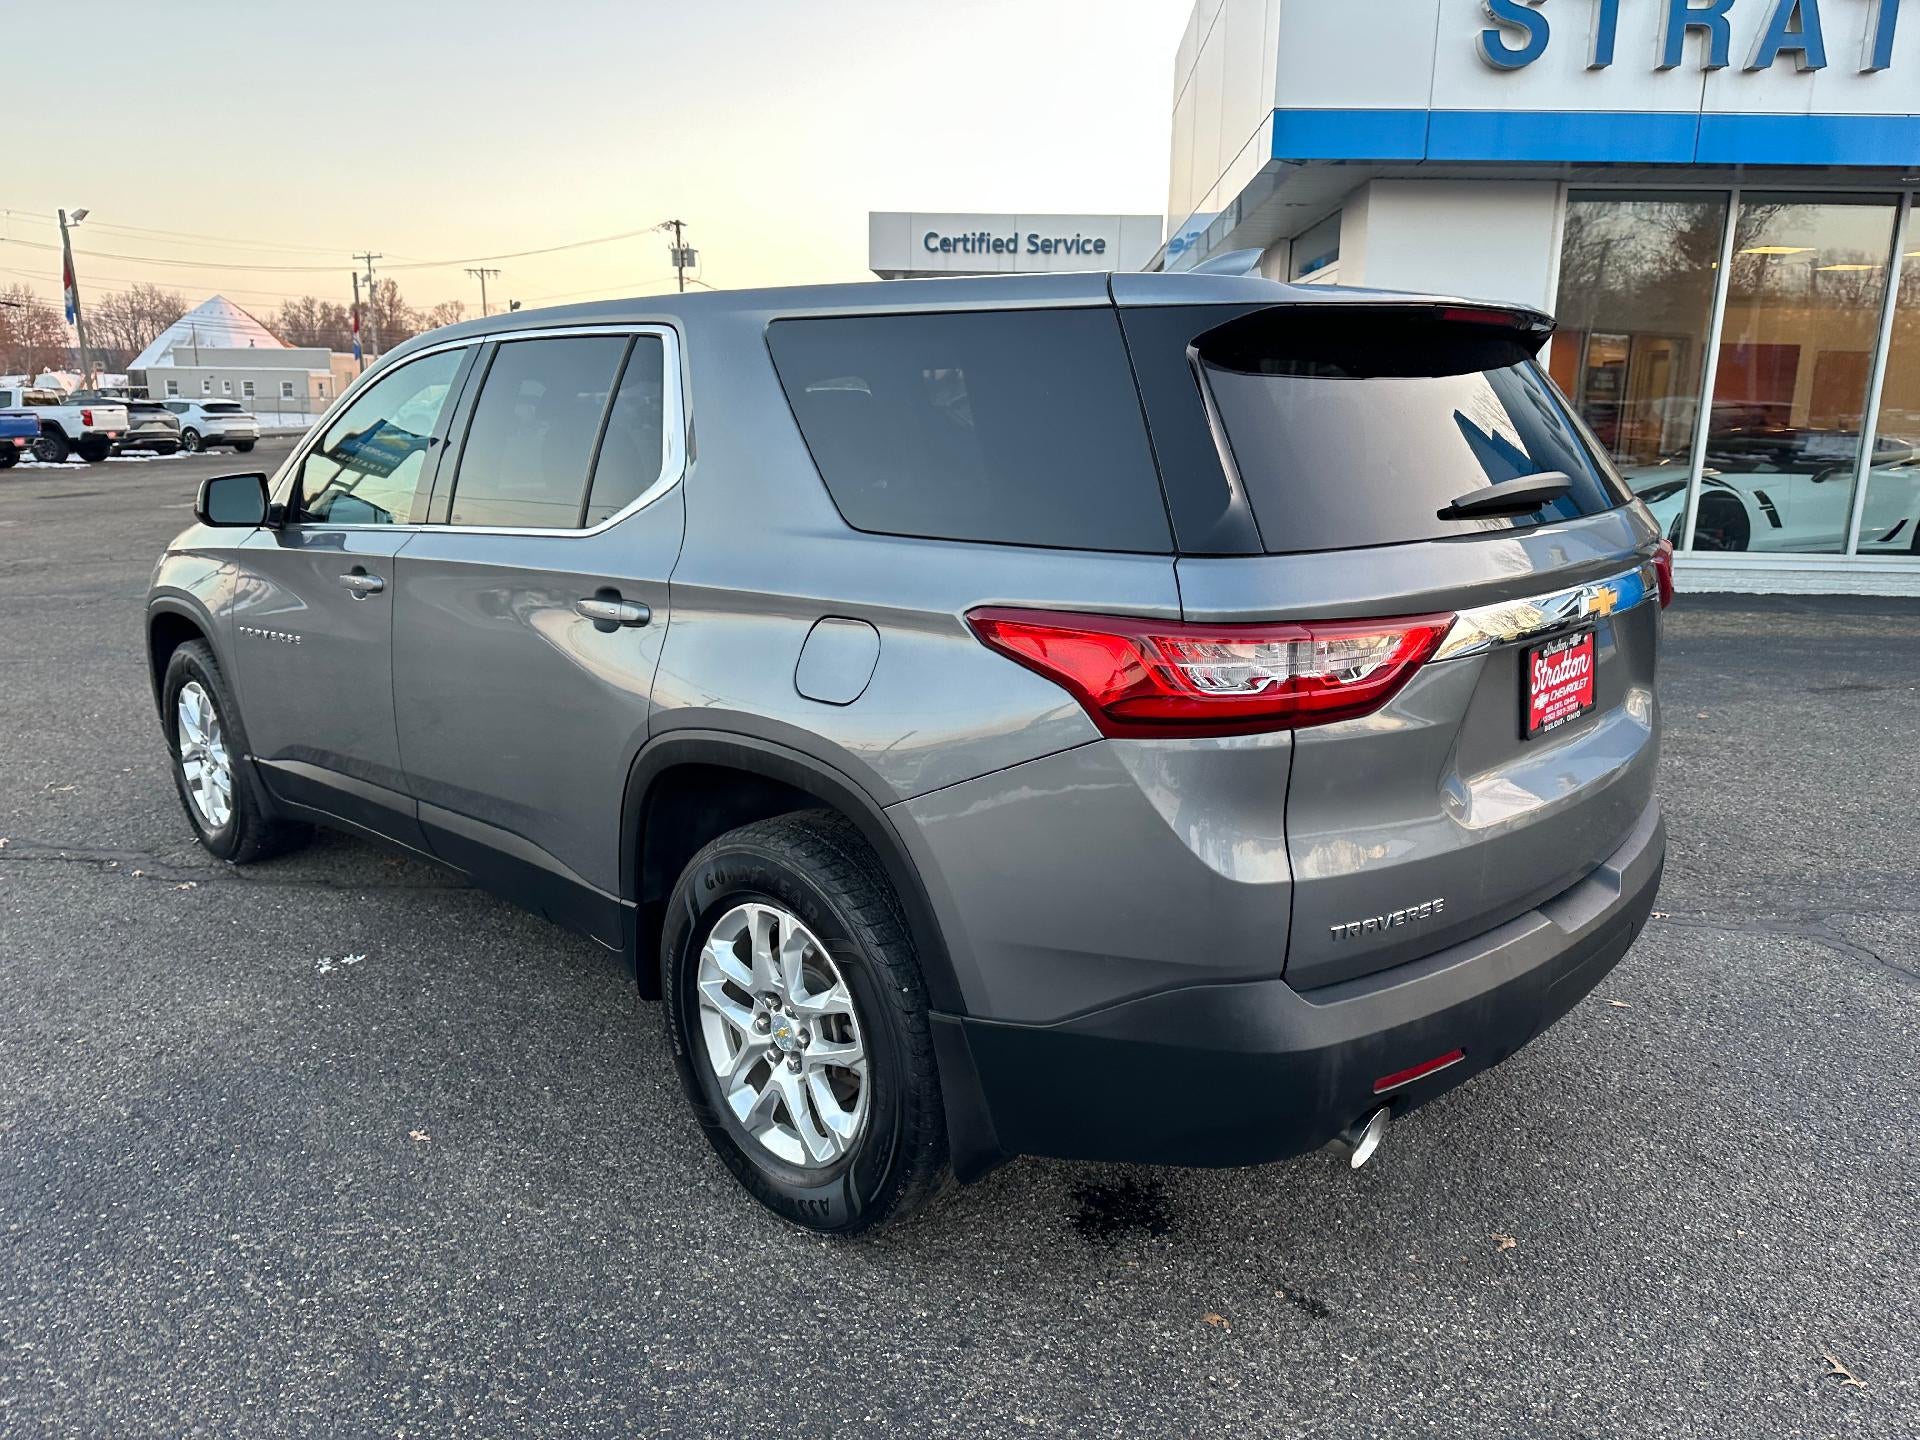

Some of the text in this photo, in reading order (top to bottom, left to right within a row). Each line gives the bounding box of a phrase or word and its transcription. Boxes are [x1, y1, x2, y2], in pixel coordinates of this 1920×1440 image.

[923, 231, 1107, 255] Certified Service
[239, 626, 301, 645] TRAVERSE
[1531, 648, 1591, 695] Stratton
[1549, 677, 1589, 702] CHEVROLET
[1330, 898, 1445, 941] TRAVERSE
